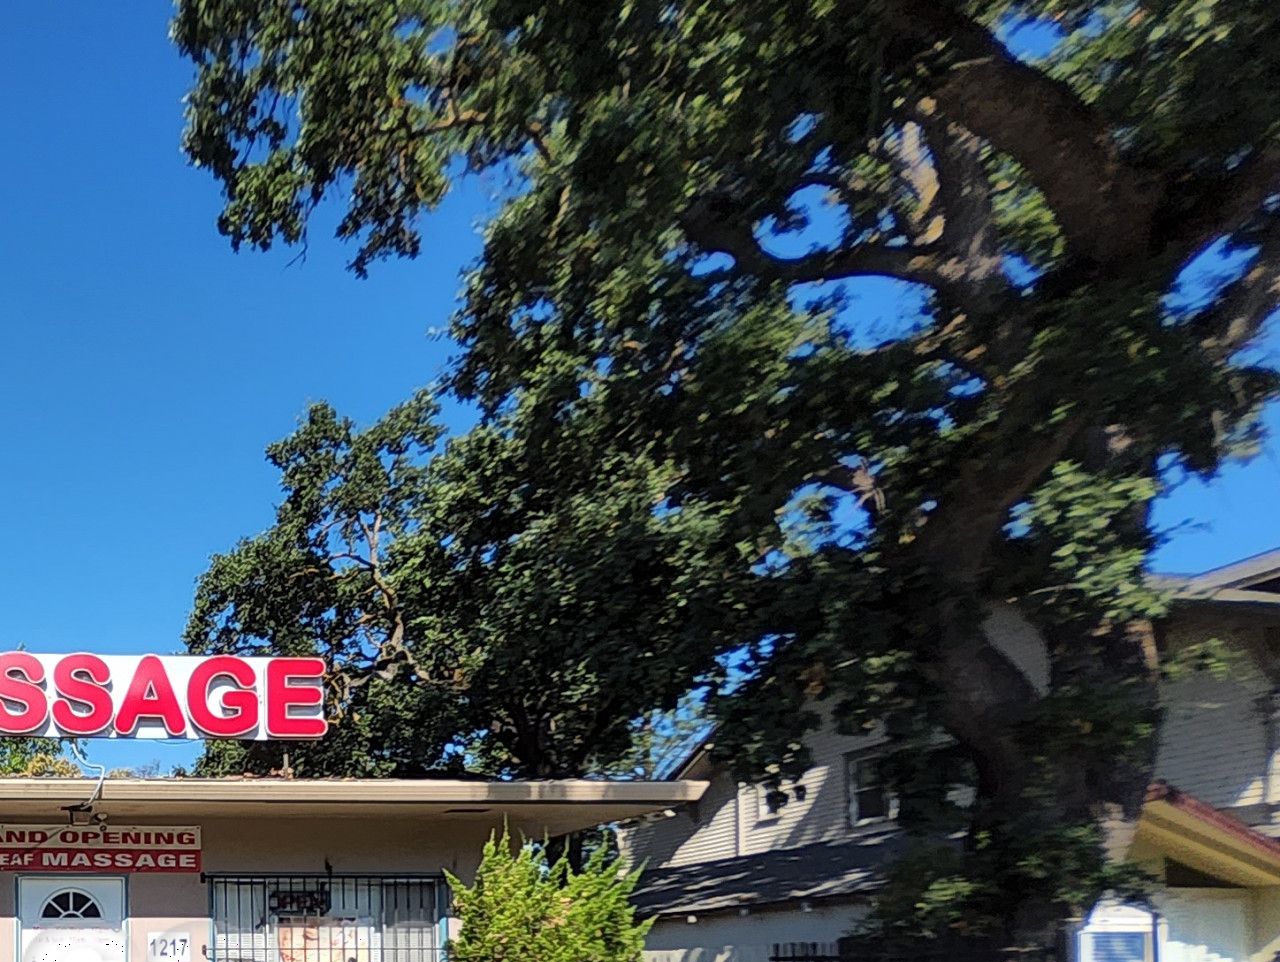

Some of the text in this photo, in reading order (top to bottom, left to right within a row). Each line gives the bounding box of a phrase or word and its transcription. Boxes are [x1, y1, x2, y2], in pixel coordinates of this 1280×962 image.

[60, 829, 196, 846] OPENING
[43, 852, 196, 867] MASSAGE
[149, 938, 189, 957] 1217
